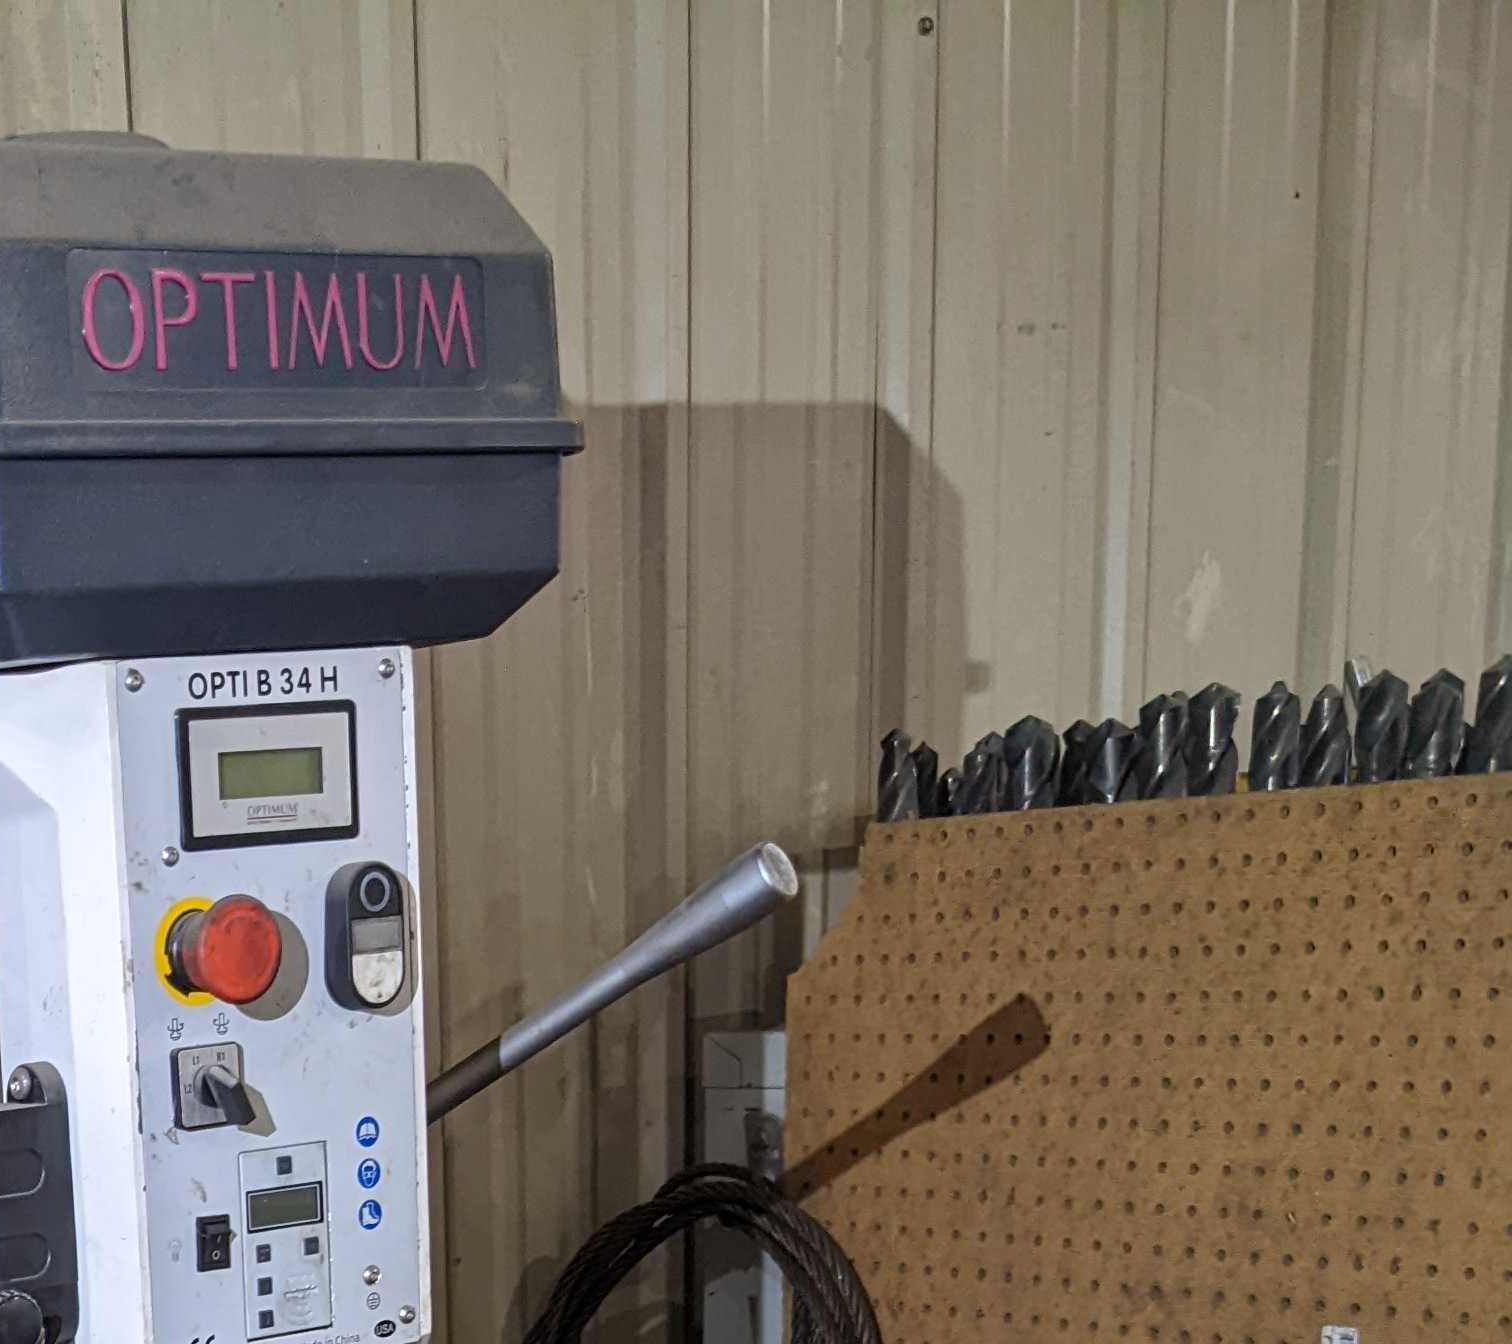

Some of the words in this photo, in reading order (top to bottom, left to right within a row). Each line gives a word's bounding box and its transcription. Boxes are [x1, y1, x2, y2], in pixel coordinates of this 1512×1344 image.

[81, 267, 478, 371] OPTIMUM
[188, 670, 248, 700] OPTI
[257, 669, 272, 696] B
[280, 667, 312, 695] 34
[320, 665, 338, 692] H
